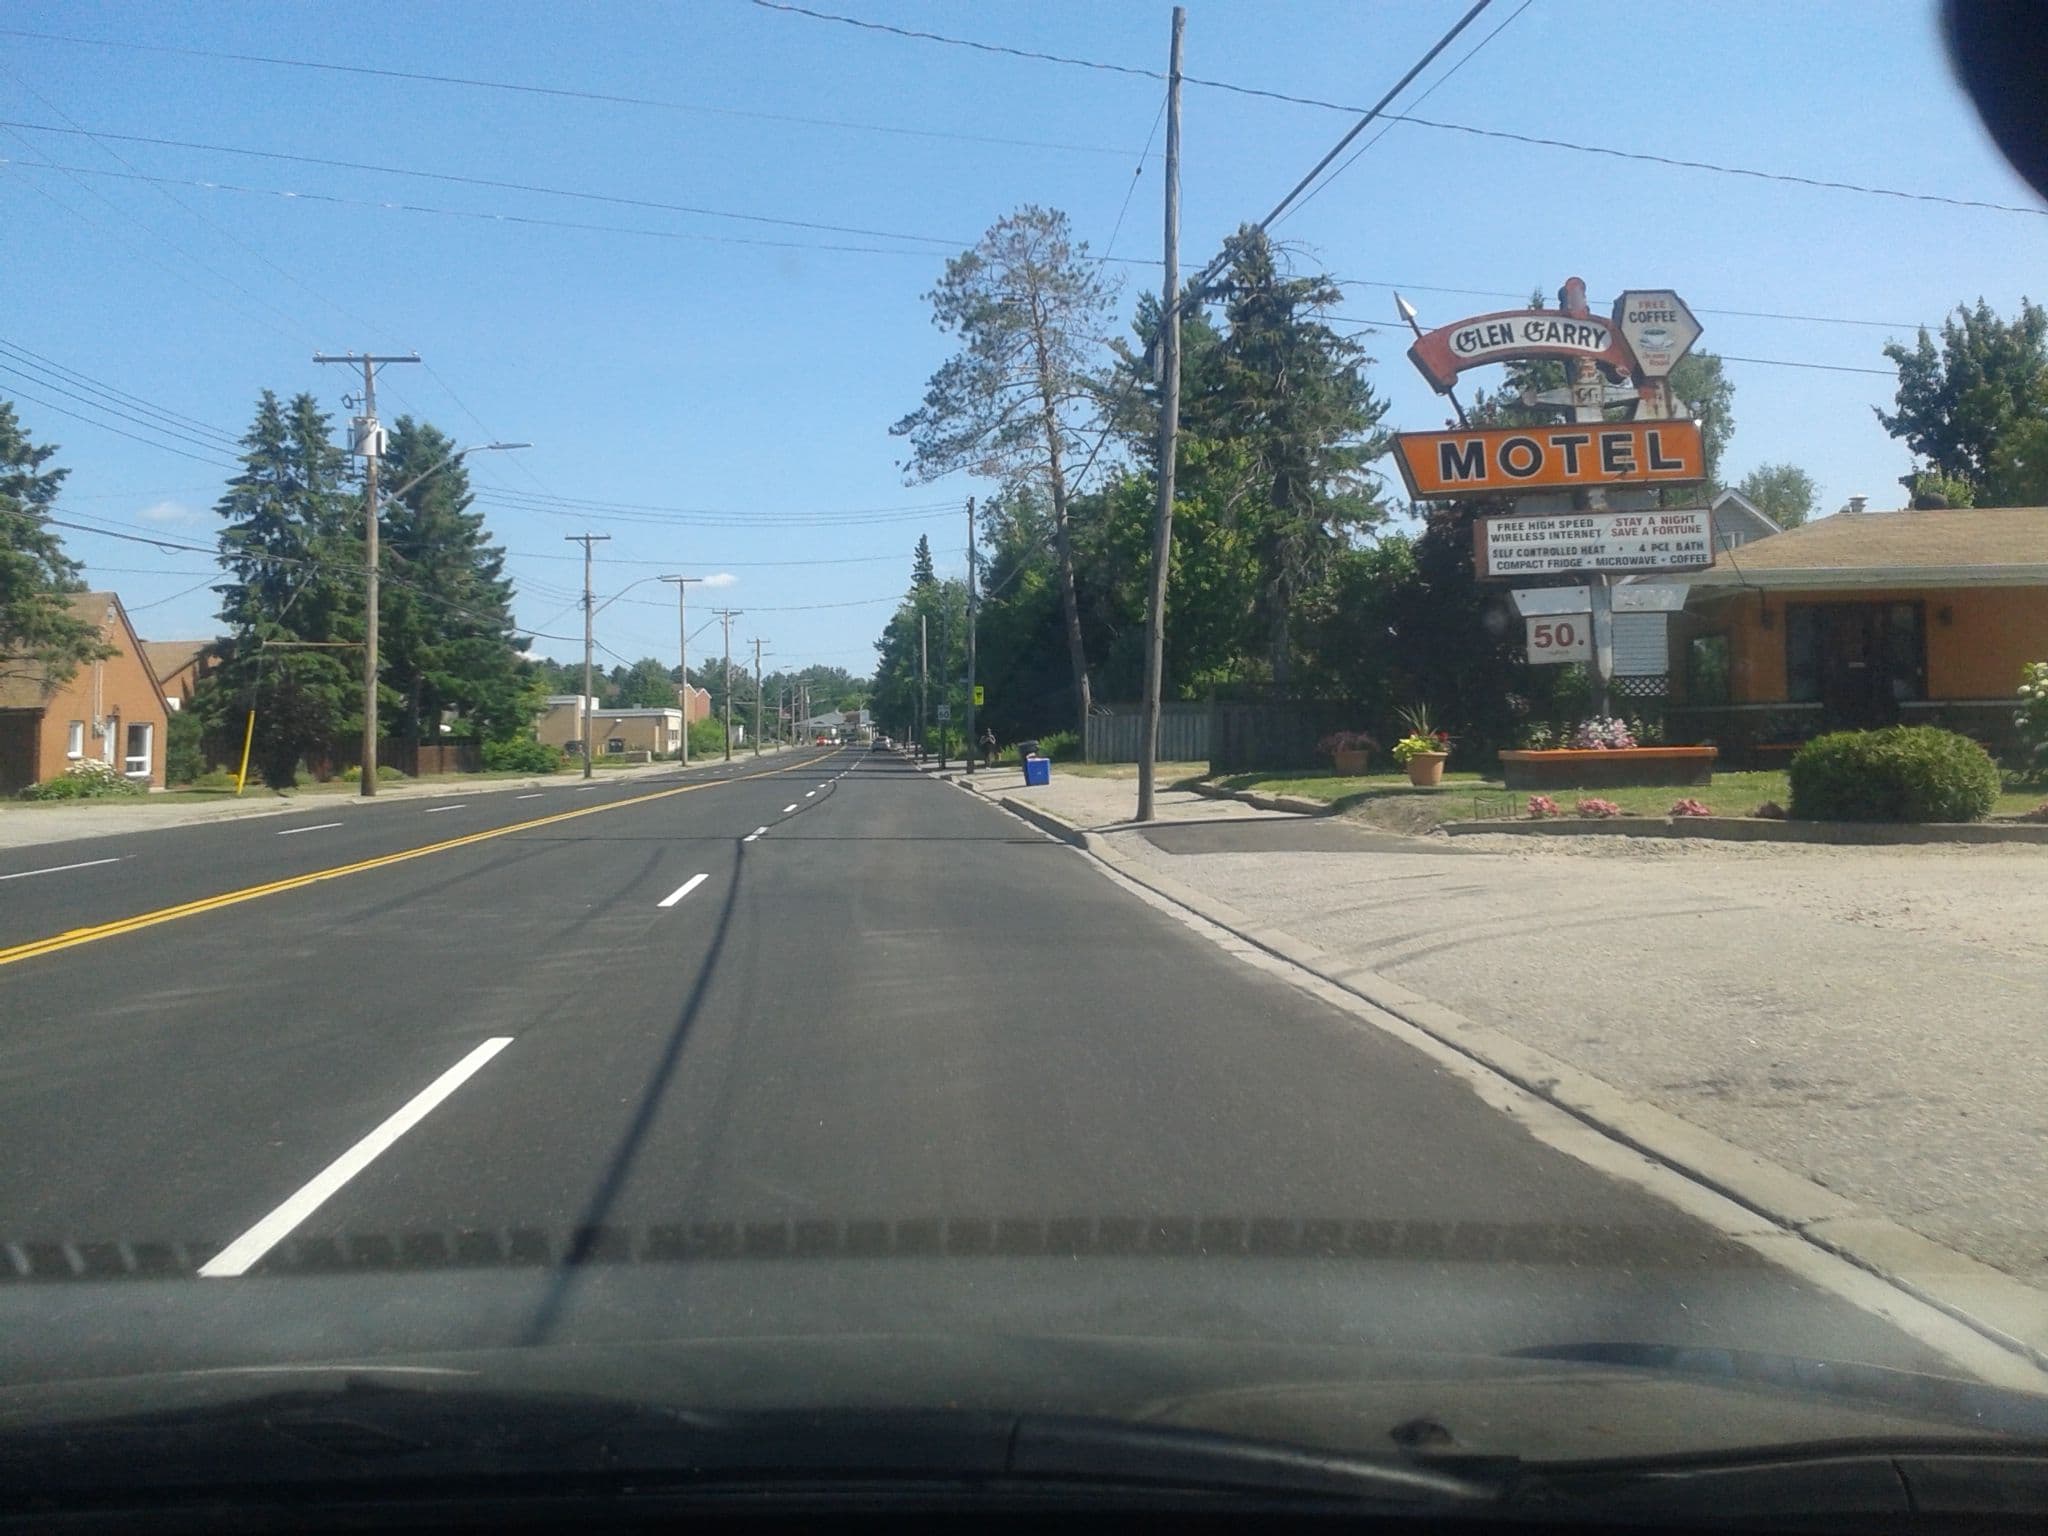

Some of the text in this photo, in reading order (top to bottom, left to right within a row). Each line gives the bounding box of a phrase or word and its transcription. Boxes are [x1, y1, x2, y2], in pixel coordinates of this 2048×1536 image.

[1629, 310, 1677, 323] COFFEE
[1456, 319, 1606, 353] GLEN GARRY
[1438, 431, 1684, 481] MOTEL
[1497, 518, 1594, 531] FREE HIGH SPEED
[1615, 515, 1696, 527] STAY A NIGHT
[1490, 529, 1602, 542] WIRELESS INTERNET
[1611, 525, 1703, 537] SAVE A FORTUNE
[1492, 549, 1513, 558] SELF
[1516, 546, 1578, 557] CONTROLLED
[1581, 545, 1606, 555] HEAT
[1676, 541, 1704, 551] BATH
[1496, 554, 1708, 570] COMPACT FRIDGE MICROWAVE COFFEE
